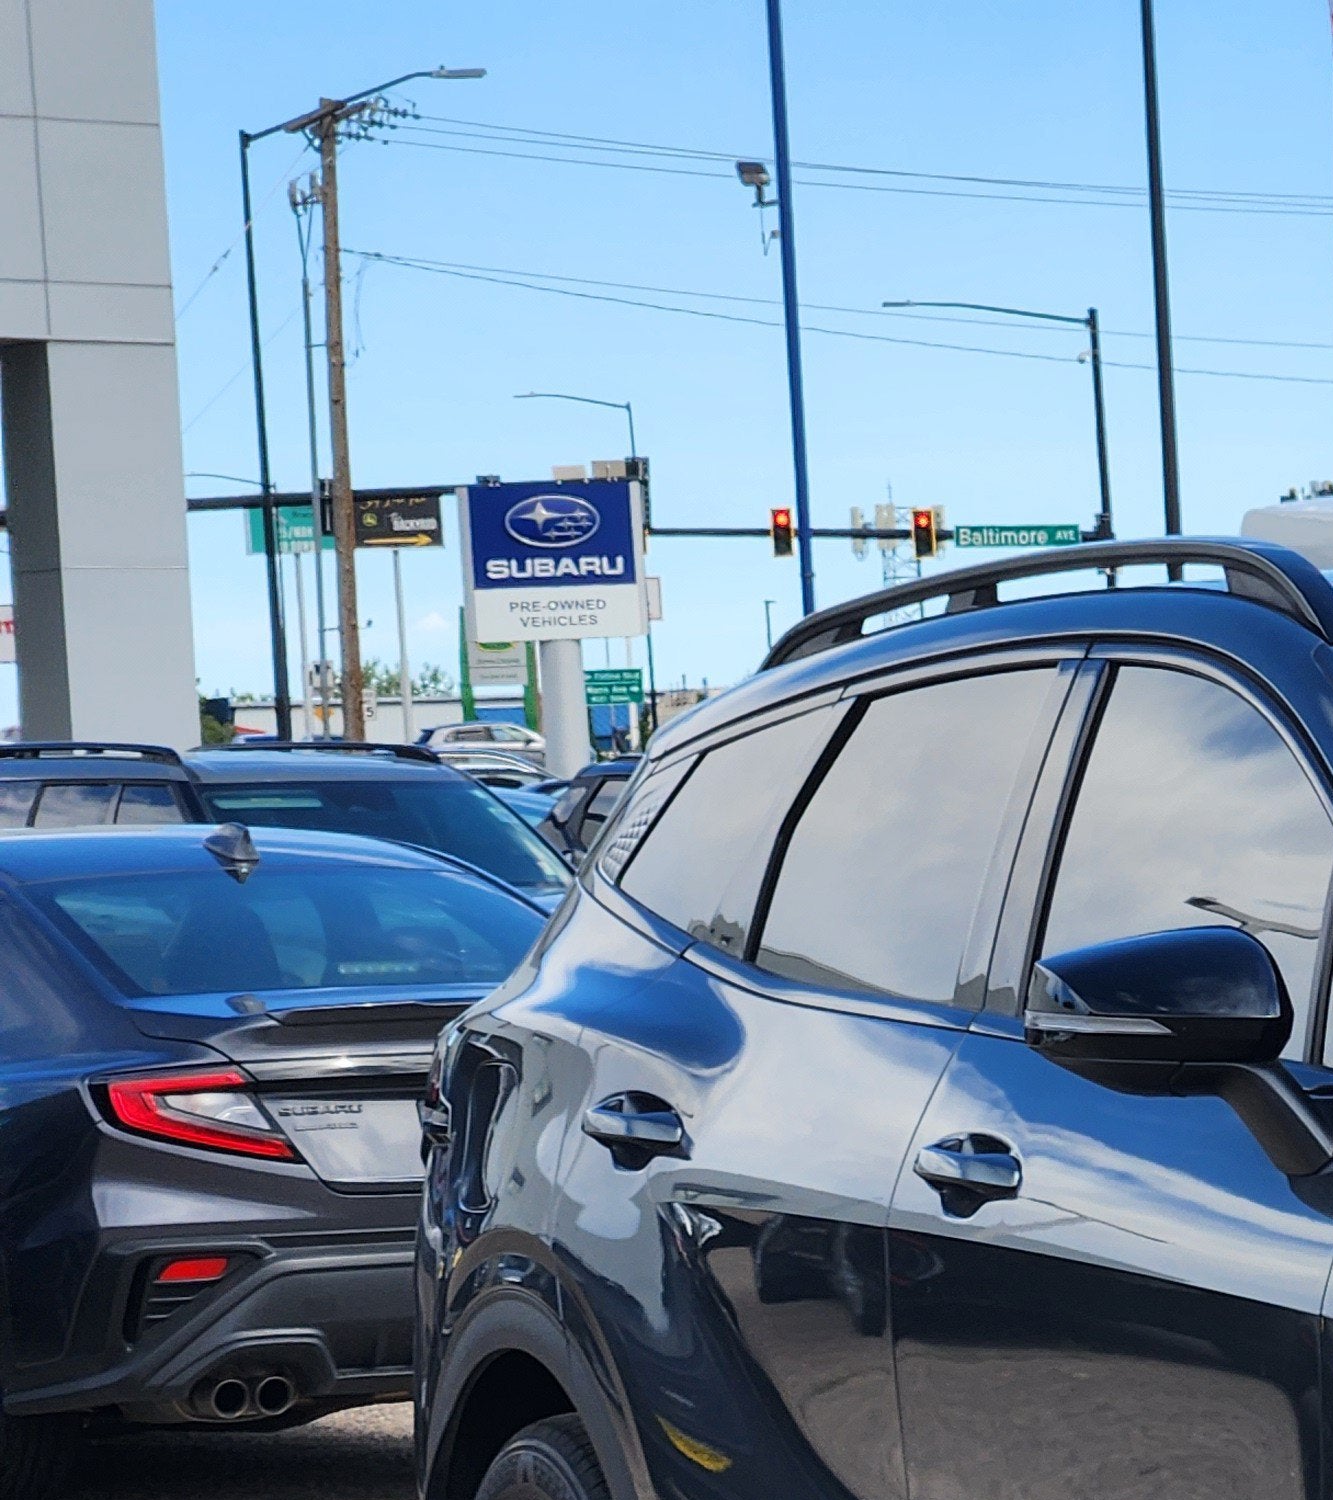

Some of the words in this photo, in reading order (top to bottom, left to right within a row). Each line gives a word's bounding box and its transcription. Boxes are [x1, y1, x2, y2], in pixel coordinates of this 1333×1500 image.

[959, 528, 1049, 547] Baltimore
[1055, 529, 1076, 541] AVE
[486, 555, 625, 580] SUBARU
[509, 599, 607, 613] PRE-OWNED
[519, 614, 598, 628] VEHICLES
[278, 1104, 363, 1117] SUBARU
